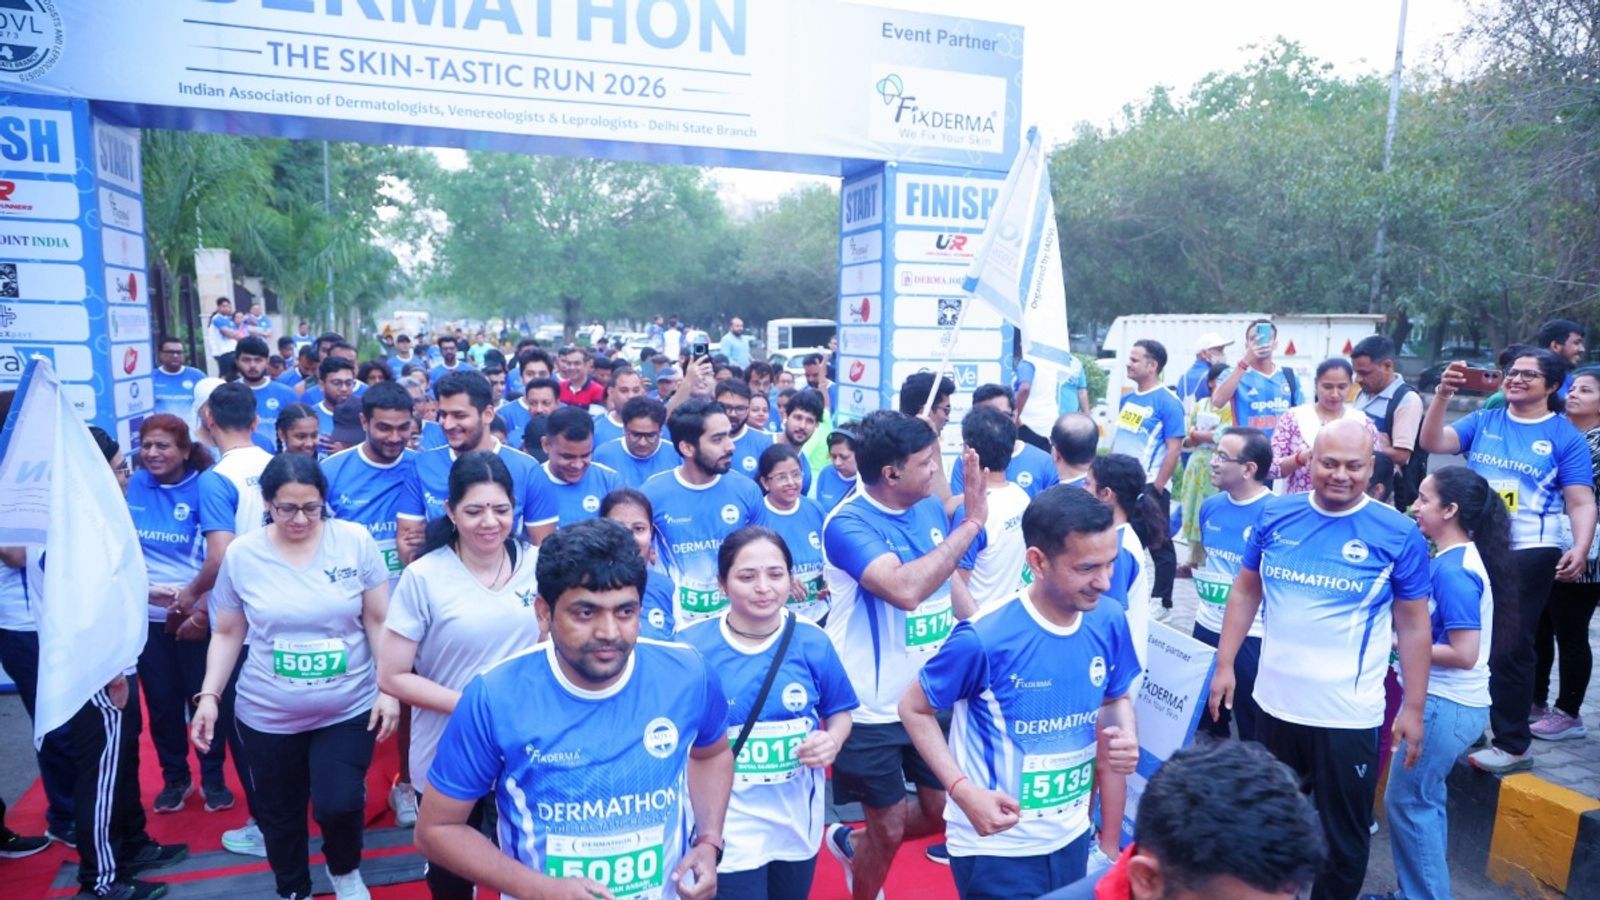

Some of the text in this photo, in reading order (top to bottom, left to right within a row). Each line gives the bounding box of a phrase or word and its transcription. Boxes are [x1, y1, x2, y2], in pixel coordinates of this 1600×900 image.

[201, 0, 747, 55] MATHON
[882, 22, 998, 51] Event Partner
[267, 41, 667, 98] THE SKIN-TASTIC RUN 2026
[179, 82, 225, 97] Indian
[229, 86, 312, 104] Association
[316, 94, 332, 106] of
[336, 95, 444, 116] Dermatologists,
[448, 104, 545, 124] Venereologists
[549, 112, 559, 123] &
[562, 113, 639, 131] Leprologists
[649, 119, 680, 133] Delhi
[683, 122, 713, 135] State
[716, 124, 757, 138] Branch
[921, 129, 936, 141] Fix
[941, 132, 965, 144] Your
[968, 134, 991, 147] Skin
[846, 183, 877, 224] START
[32, 235, 70, 248] INDIA
[1251, 397, 1290, 412] apollo
[1471, 453, 1542, 477] DERMATHON
[1265, 565, 1364, 593] DERMATHON
[687, 591, 728, 606] 519
[283, 652, 342, 672] 5037
[1147, 635, 1191, 662] Event partner
[1033, 763, 1092, 798] 5139
[537, 787, 676, 822] DERMATHON
